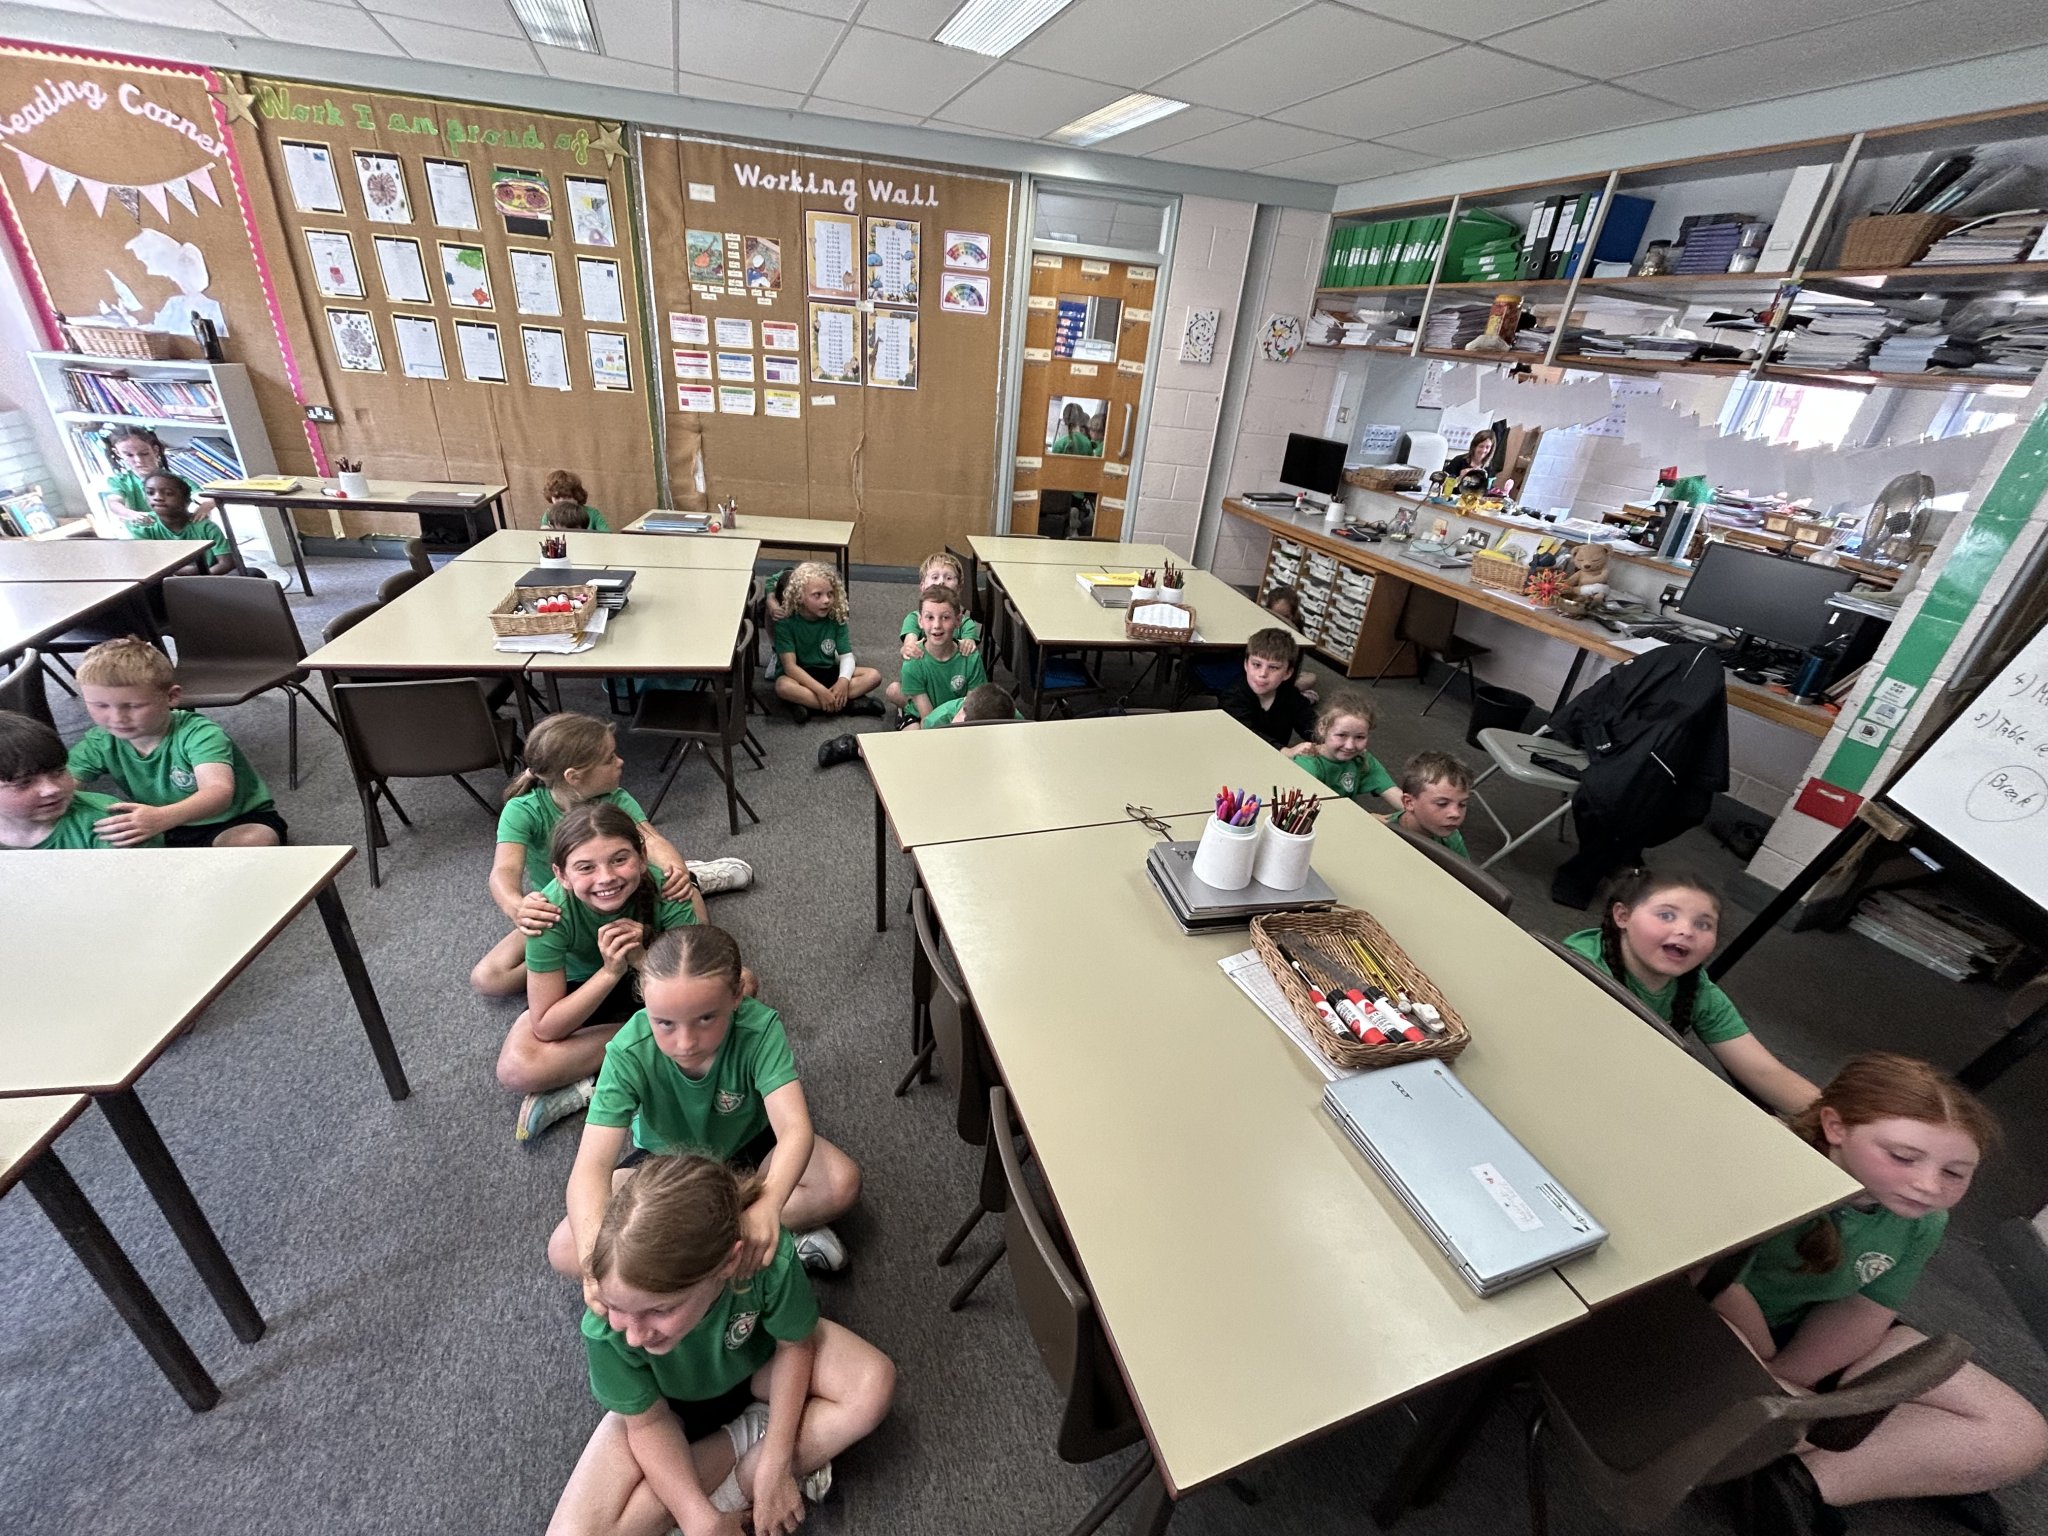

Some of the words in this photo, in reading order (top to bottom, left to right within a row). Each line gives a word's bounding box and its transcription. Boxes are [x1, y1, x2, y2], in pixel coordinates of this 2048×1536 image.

[0, 78, 107, 141] eading
[118, 83, 228, 157] Corner
[251, 85, 344, 127] Work
[352, 104, 376, 130] I
[388, 114, 438, 135] am
[446, 119, 544, 158] proud
[554, 128, 590, 166] of
[733, 163, 857, 211] Working
[868, 178, 939, 207] Wall
[1974, 709, 2001, 729] 5)
[1995, 716, 2029, 744] Table
[1987, 772, 2039, 808] Break
[1391, 1080, 1413, 1100] acer
